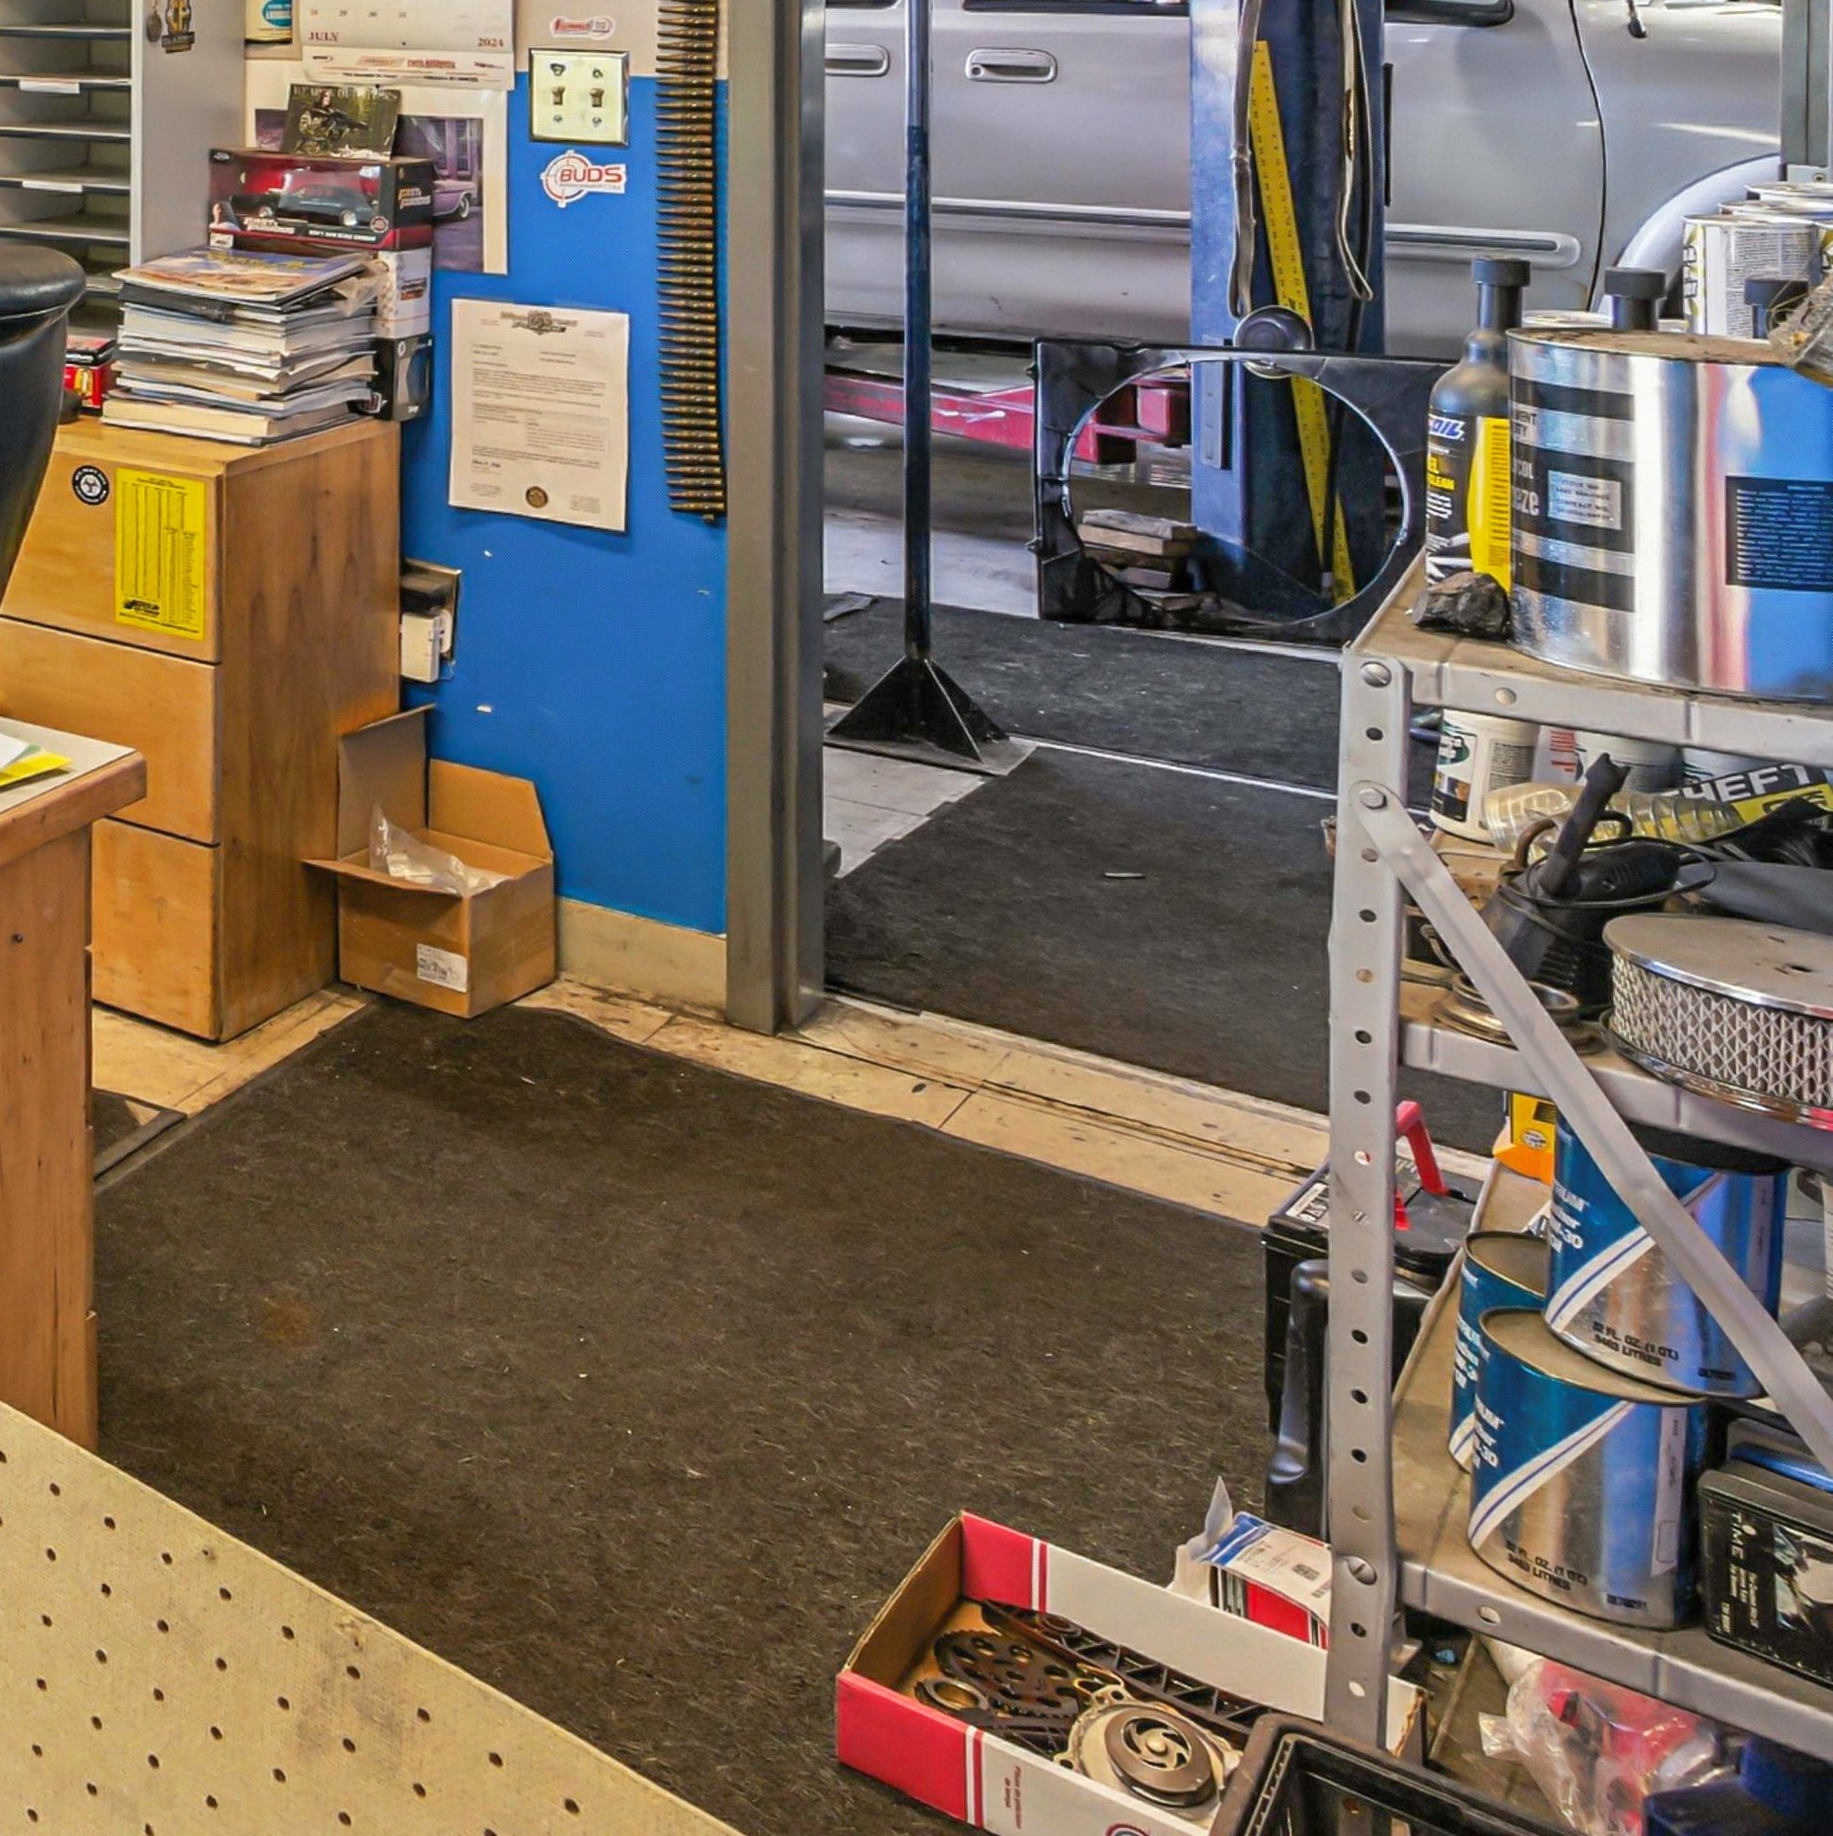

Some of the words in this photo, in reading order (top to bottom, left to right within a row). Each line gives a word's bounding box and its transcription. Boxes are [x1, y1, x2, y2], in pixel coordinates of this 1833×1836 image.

[308, 32, 339, 42] JULY
[560, 166, 623, 183] BUDS
[1622, 1345, 1662, 1368] LITRES
[1731, 1511, 1745, 1561] TIME
[1532, 1566, 1572, 1591] LITRES
